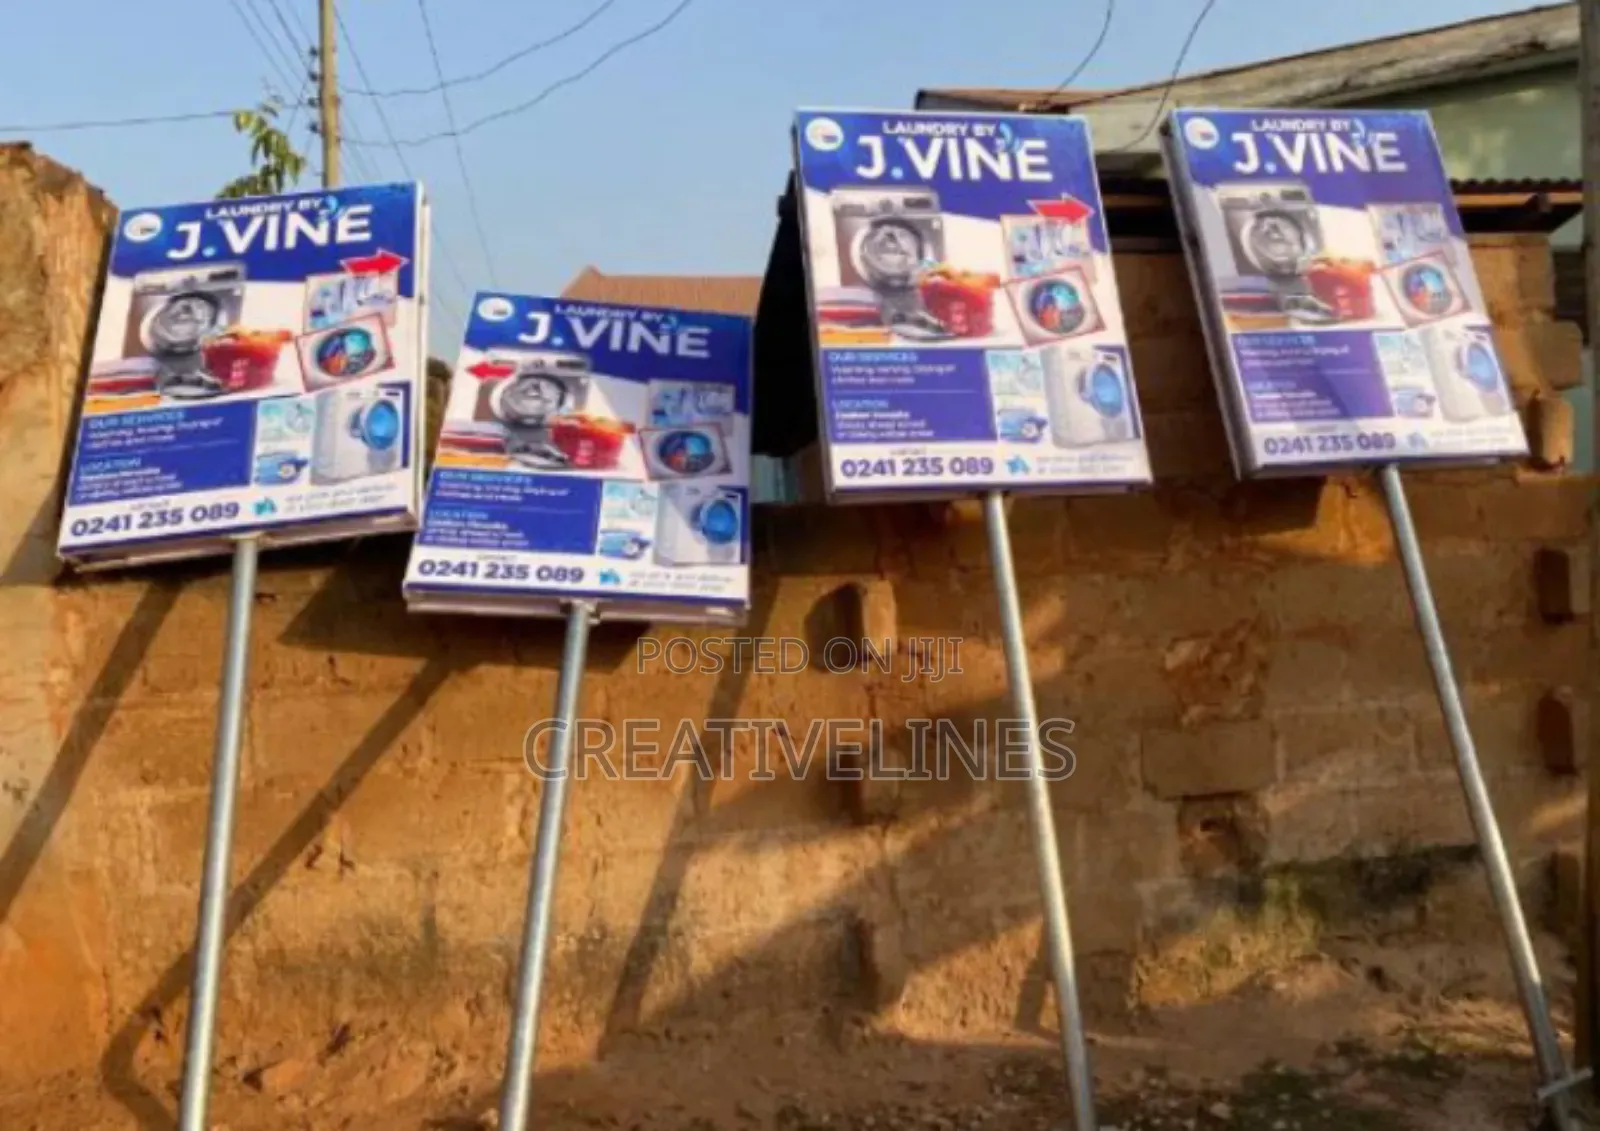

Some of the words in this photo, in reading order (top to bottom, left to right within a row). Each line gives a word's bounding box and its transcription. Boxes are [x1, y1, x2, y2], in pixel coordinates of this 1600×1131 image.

[883, 120, 967, 136] LAUNDRY
[973, 123, 996, 137] BY
[856, 135, 1053, 181] J.VINE
[1231, 132, 1407, 175] J.VINE
[205, 200, 294, 220] LAUNDRY
[166, 204, 373, 259] J.VINE
[554, 304, 638, 321] LAUNDRY
[517, 311, 711, 358] J.VINE
[1264, 436, 1314, 456] 0241
[1317, 433, 1354, 453] 235
[841, 458, 896, 478] 0241
[902, 456, 944, 476] 235
[949, 456, 994, 475] 089
[70, 515, 132, 537] 0241
[137, 508, 183, 530] 235
[189, 502, 240, 524] 089
[418, 559, 479, 579] 0241
[484, 560, 529, 581] 235
[536, 563, 585, 584] 089
